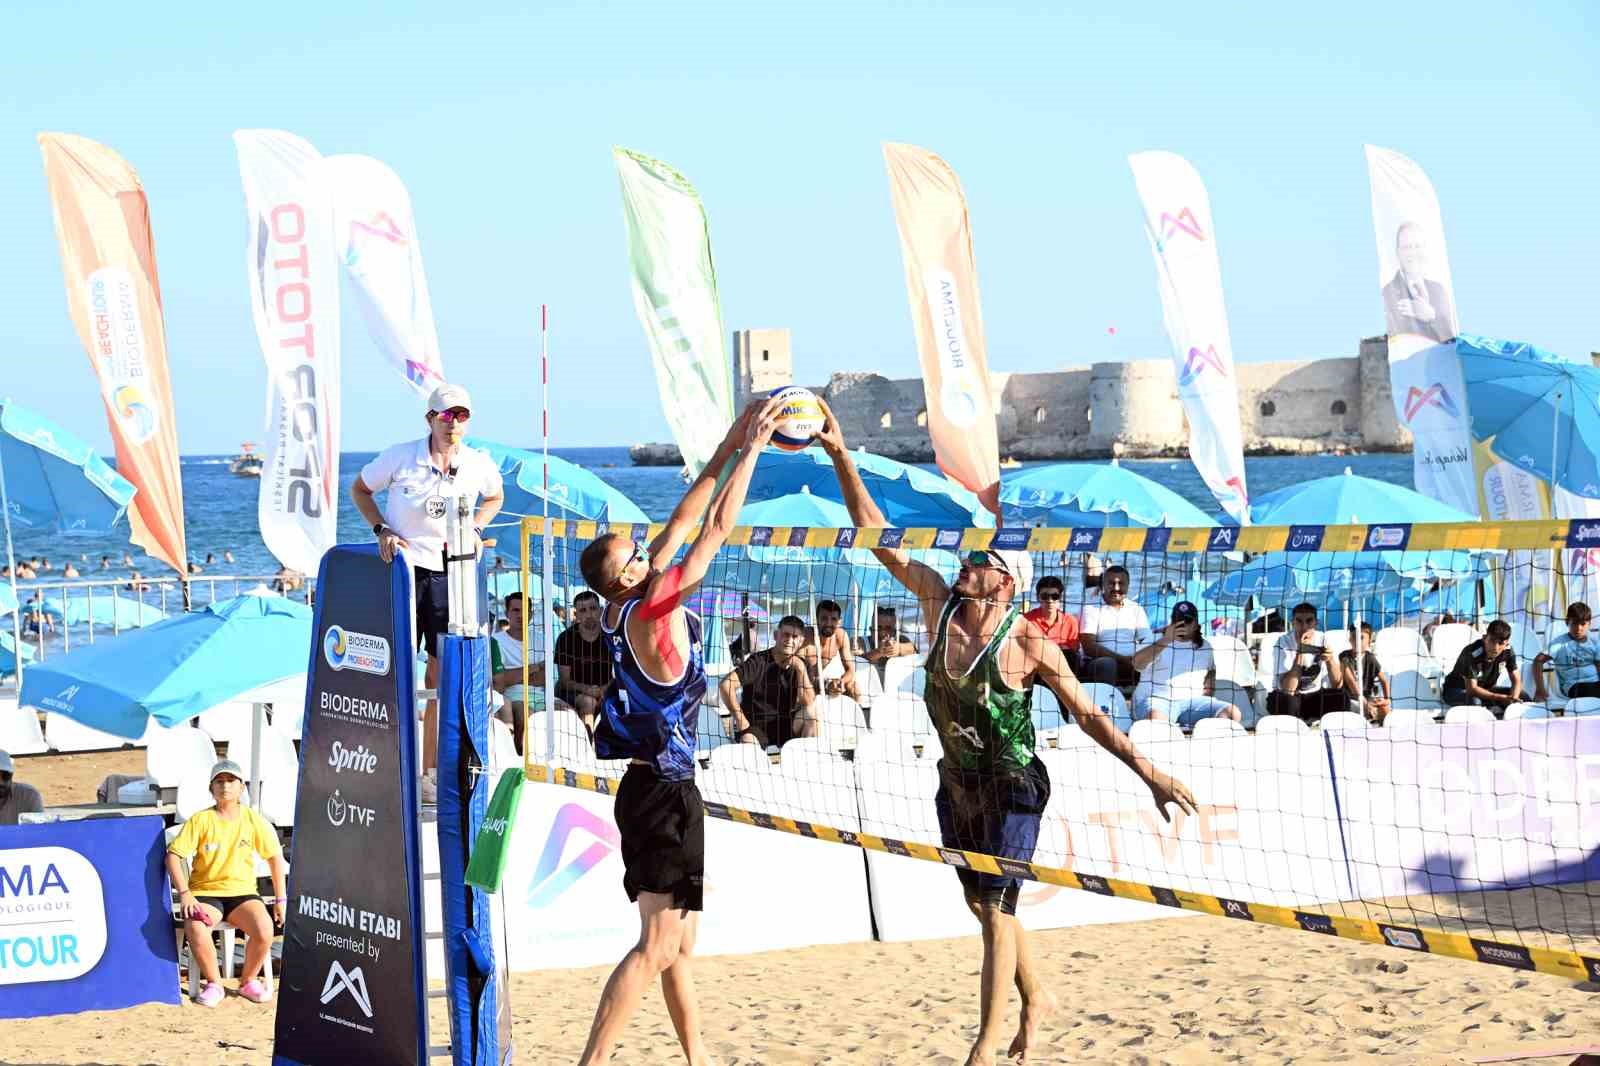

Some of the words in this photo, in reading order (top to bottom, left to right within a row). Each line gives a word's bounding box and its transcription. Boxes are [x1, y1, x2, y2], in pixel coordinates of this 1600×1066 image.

[348, 635, 385, 651] BIODERMA
[320, 691, 389, 722] BIODERMA
[328, 741, 377, 774] Sprite
[348, 804, 375, 827] TVF
[1088, 803, 1240, 873] TVF
[299, 895, 355, 928] MERSİN
[360, 910, 401, 940] ETABI
[316, 931, 364, 954] presented
[369, 939, 380, 962] by
